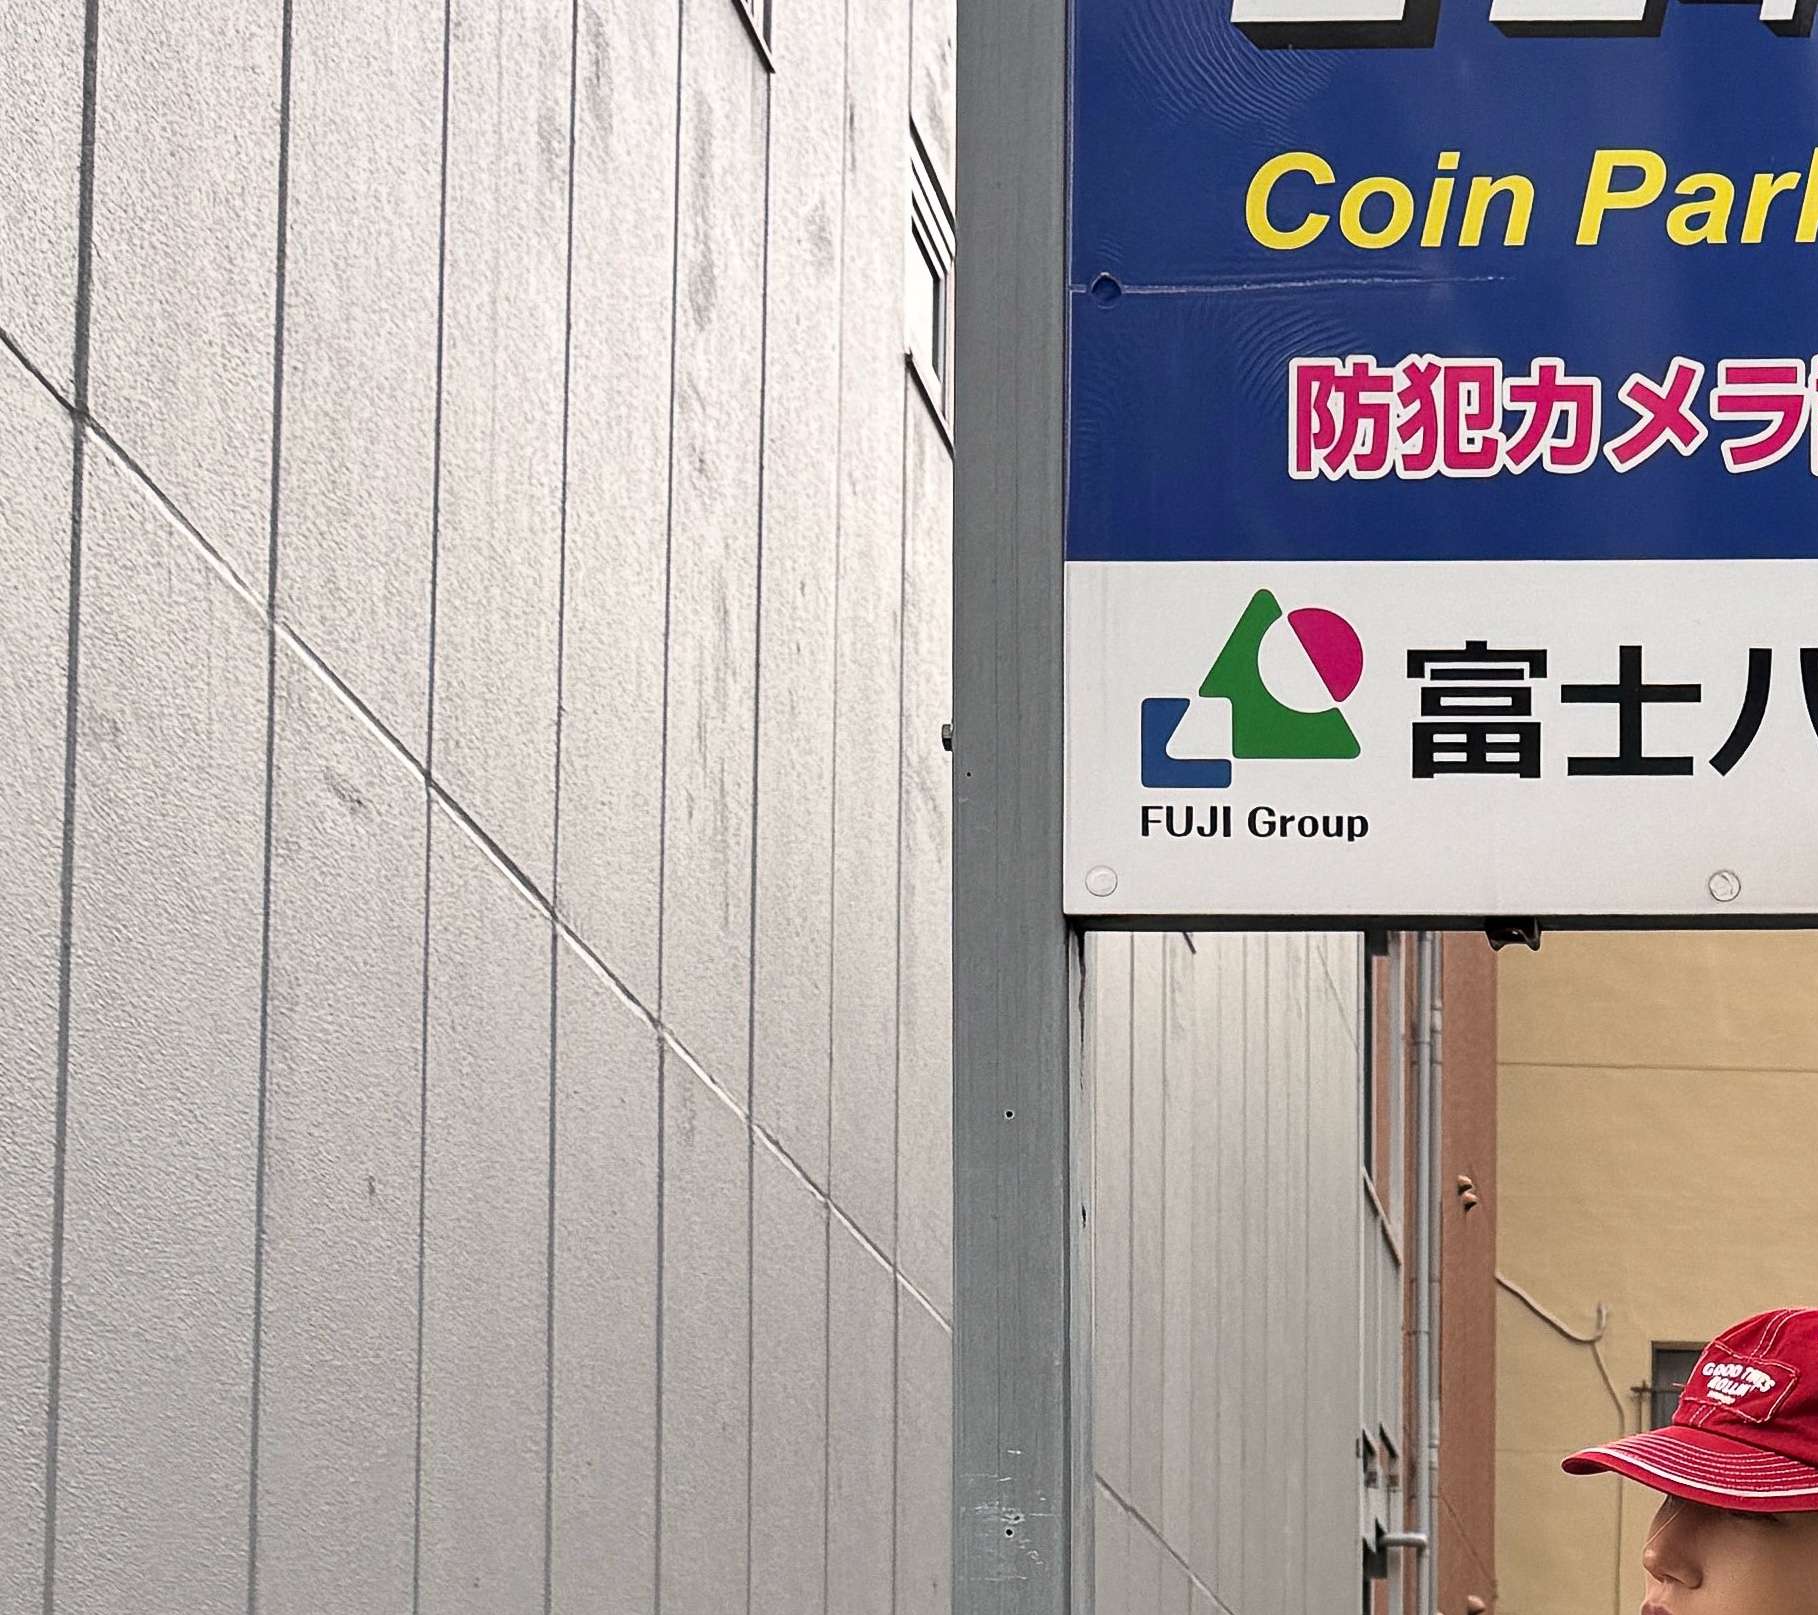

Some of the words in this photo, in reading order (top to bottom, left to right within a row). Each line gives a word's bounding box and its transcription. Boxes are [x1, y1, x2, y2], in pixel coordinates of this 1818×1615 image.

[1245, 149, 1535, 251] Coin
[1140, 805, 1232, 838] FUJI
[1246, 806, 1370, 843] Group
